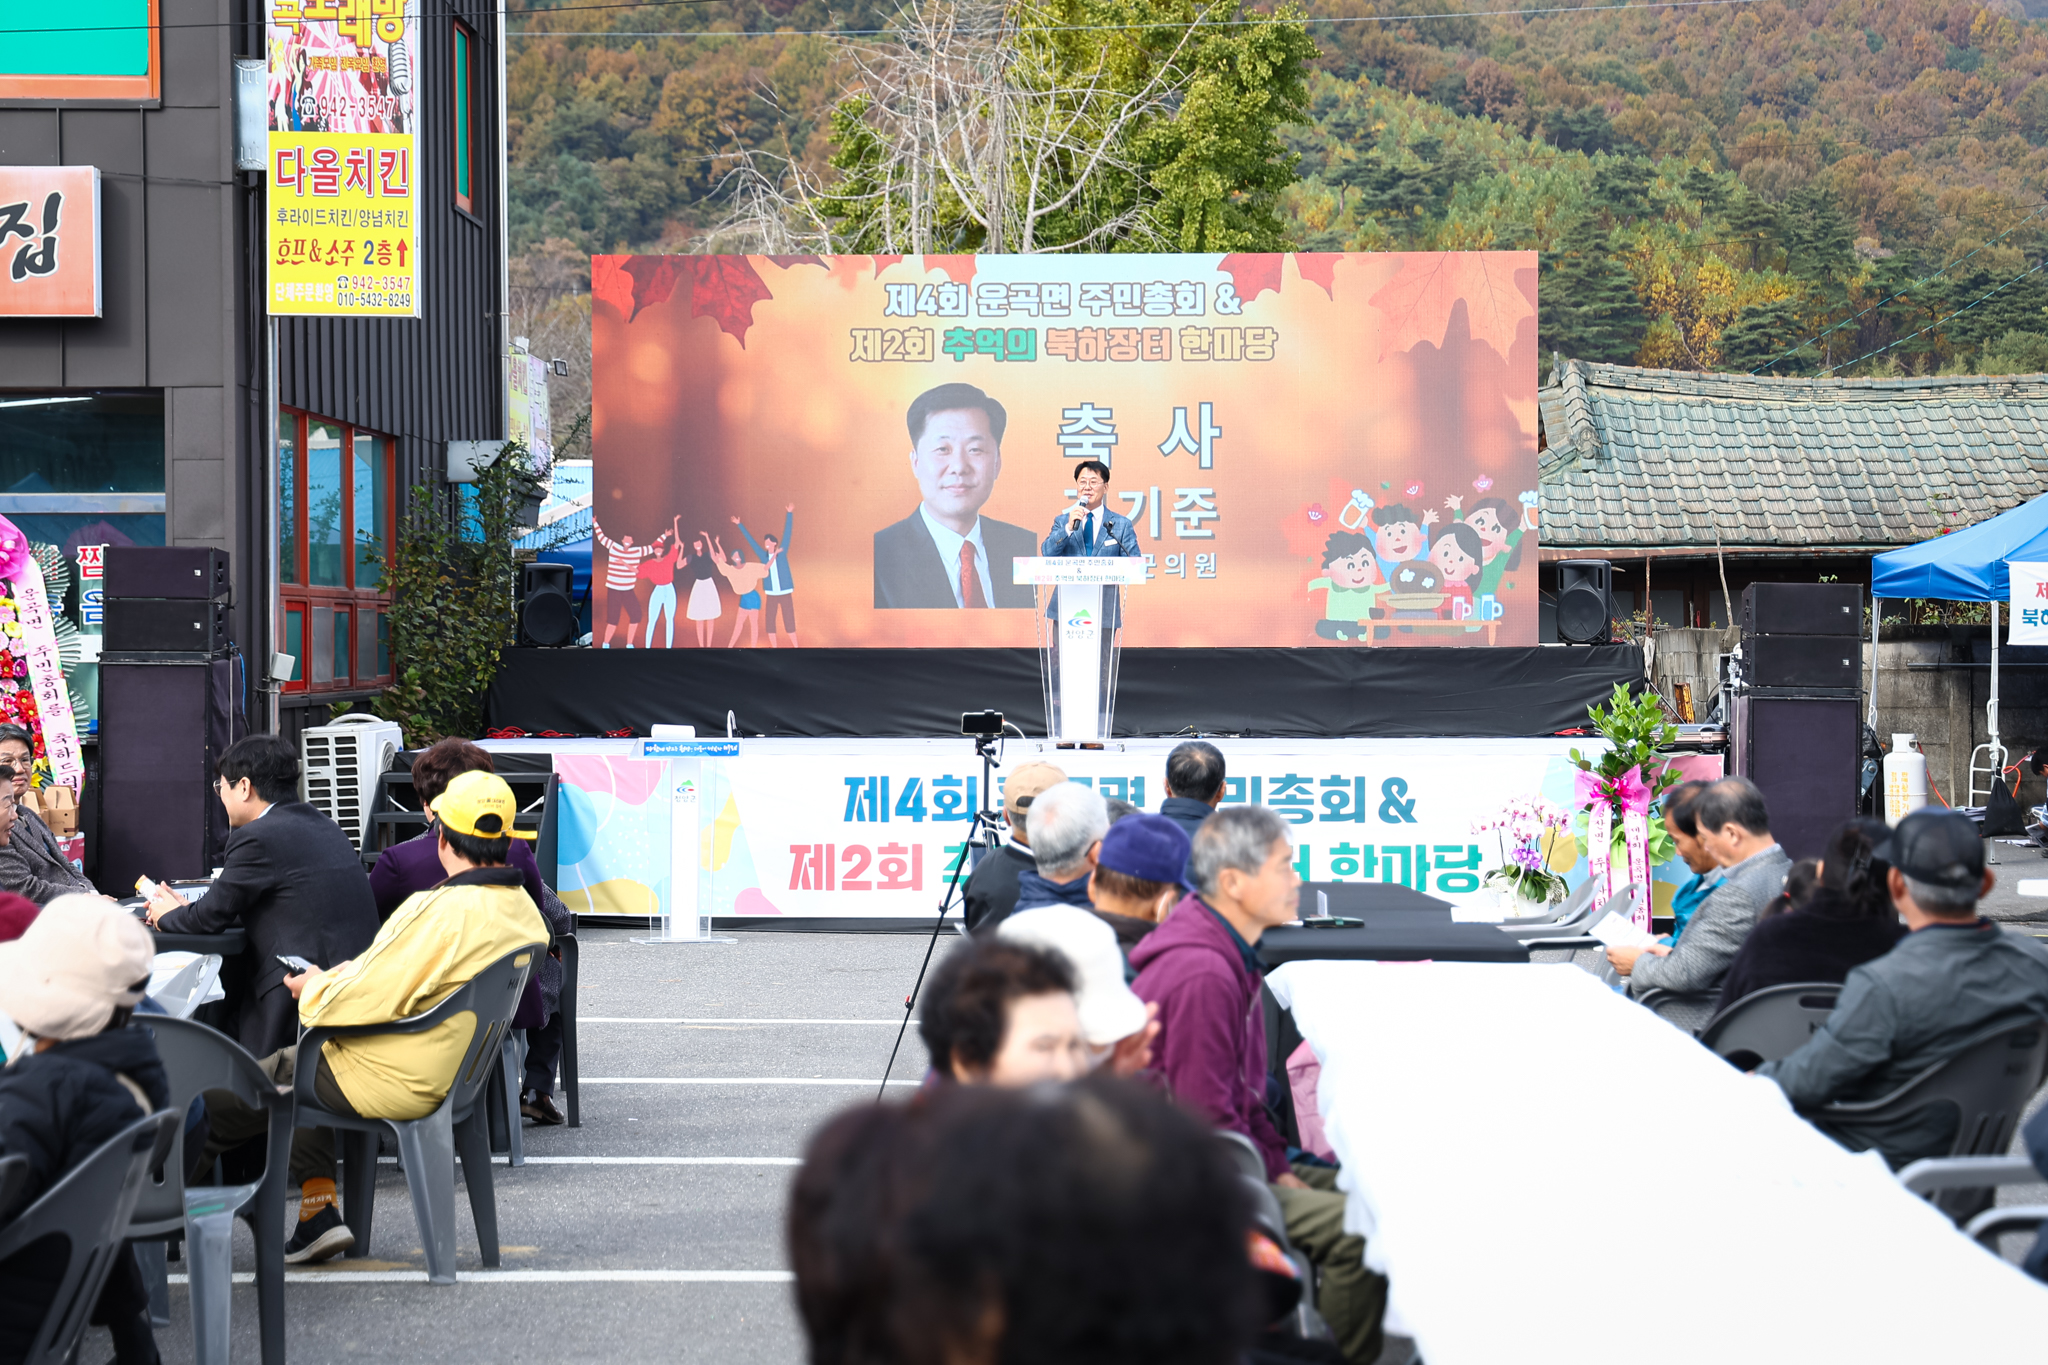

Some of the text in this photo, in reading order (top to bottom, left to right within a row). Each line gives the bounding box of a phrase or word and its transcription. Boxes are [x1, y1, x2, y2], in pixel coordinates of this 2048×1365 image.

[320, 96, 395, 119] 942-3547
[275, 146, 409, 197] 다올치킨
[277, 208, 409, 228] 후라이드치킨/양념치킨
[363, 240, 392, 266] 2층
[275, 282, 334, 303] 단체주문환영
[352, 275, 411, 290] 942-3547
[337, 292, 411, 308] 010-5432-8249
[884, 281, 1243, 317] 제4회 운곡면 주민총회 &
[849, 325, 1279, 363] 제2회 추억의 북하장터 한마당
[1062, 485, 1219, 539] 기준
[843, 774, 977, 823] 제4회
[1378, 776, 1419, 824] &
[788, 842, 923, 891] 제2회
[1329, 842, 1483, 894] 한마당
